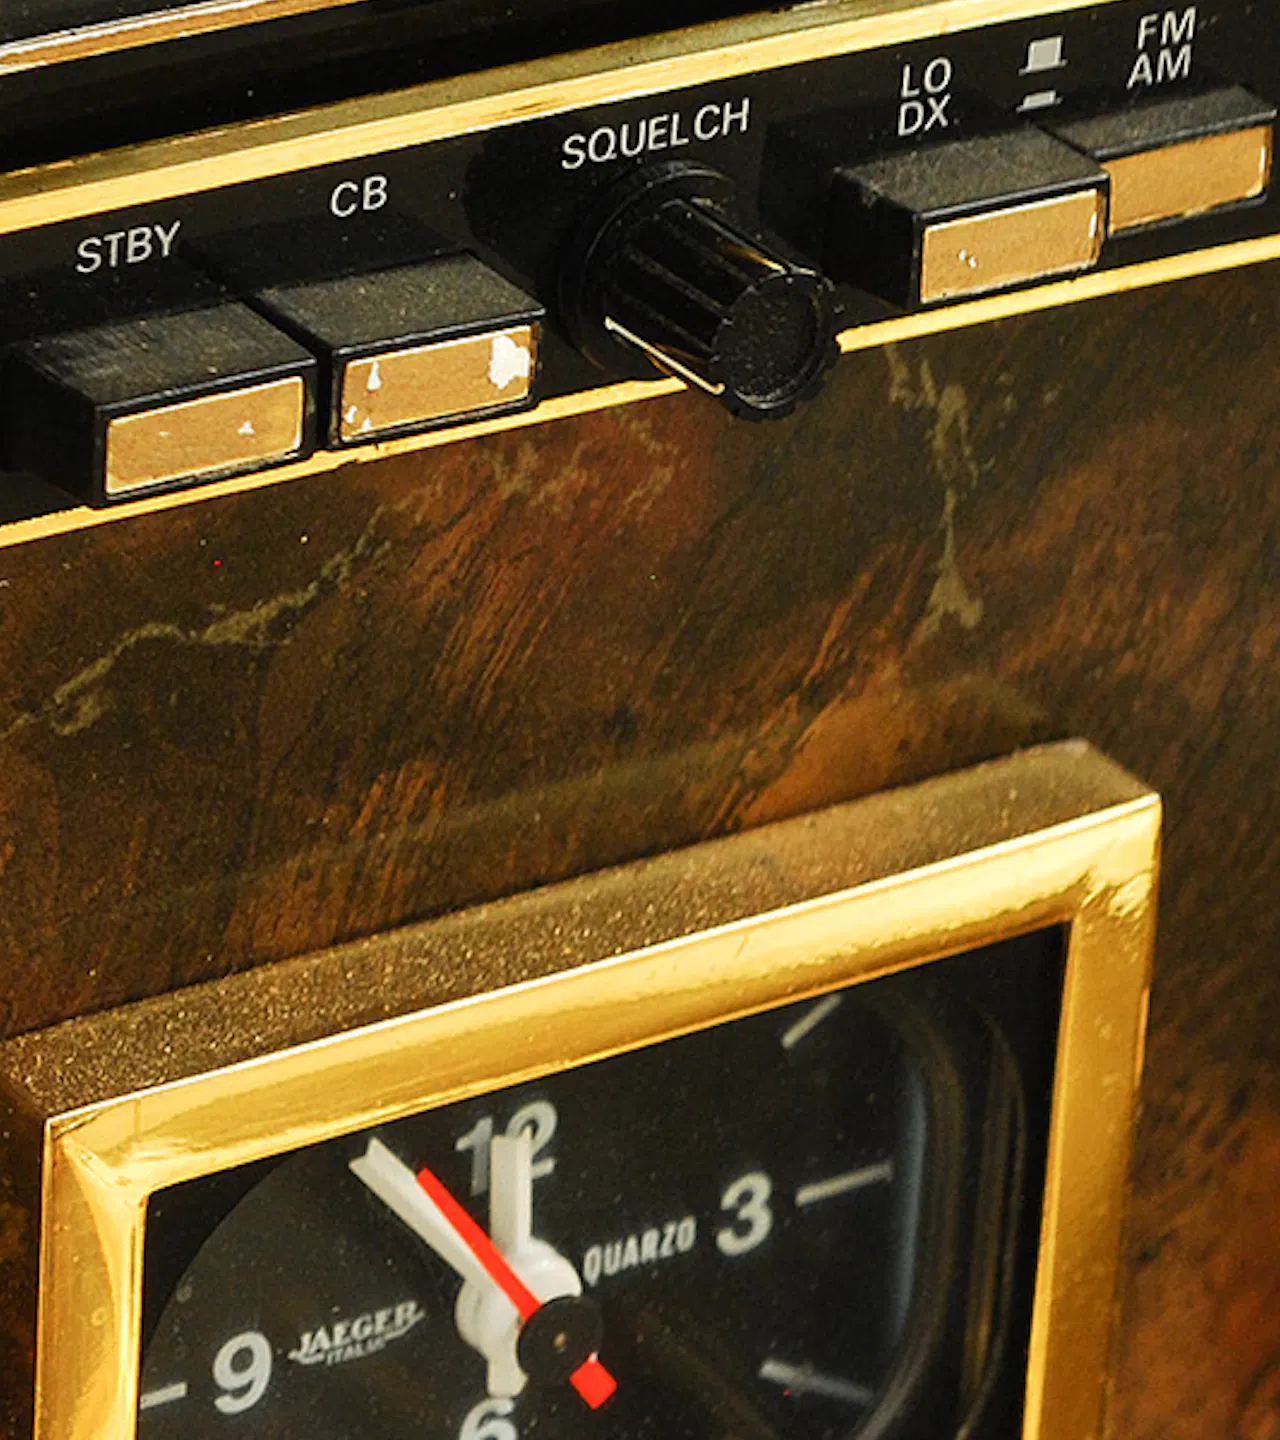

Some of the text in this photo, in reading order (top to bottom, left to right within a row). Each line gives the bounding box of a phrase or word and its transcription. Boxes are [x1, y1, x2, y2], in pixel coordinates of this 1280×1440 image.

[1137, 6, 1197, 50] FM
[901, 56, 952, 98] LO
[1126, 44, 1192, 90] AM
[560, 97, 751, 171] SQUELCH
[897, 93, 951, 137] DX
[329, 174, 388, 220] CB
[74, 220, 182, 275] STBY
[454, 1100, 558, 1197] 12
[716, 1170, 773, 1257] 3
[583, 1215, 697, 1287] QUARZO
[292, 1300, 424, 1360] JAEGER
[213, 1331, 272, 1415] 9
